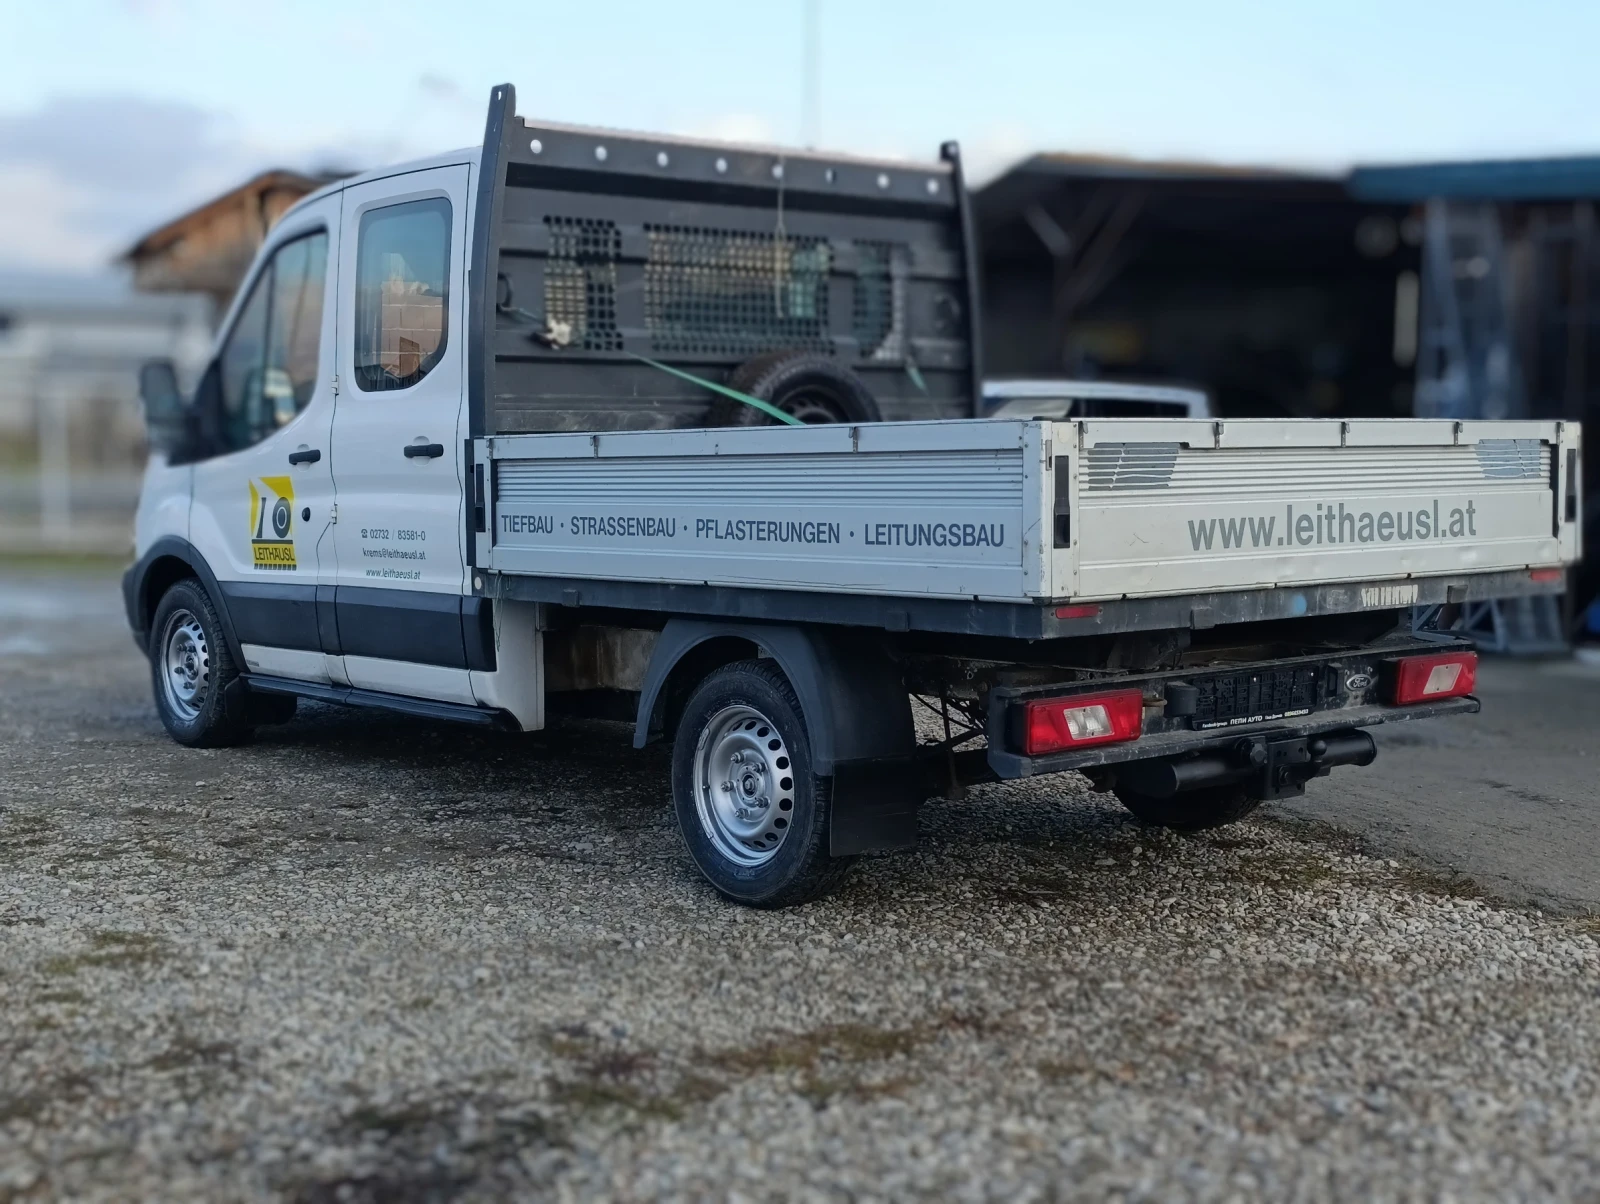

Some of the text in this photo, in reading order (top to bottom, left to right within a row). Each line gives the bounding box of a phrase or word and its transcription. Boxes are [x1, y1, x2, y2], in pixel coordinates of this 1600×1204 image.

[501, 514, 1005, 548] TIEFBAU STRASSENBAU PFLASTERUNGEN LEITUNGSBAU
[1187, 499, 1477, 551] www.leithaeusl.at
[369, 528, 390, 540] 02732
[397, 529, 426, 541] 83581-0
[362, 547, 427, 561] krems@leithaeusl.at
[365, 567, 421, 580] www.leithaeusl.at
